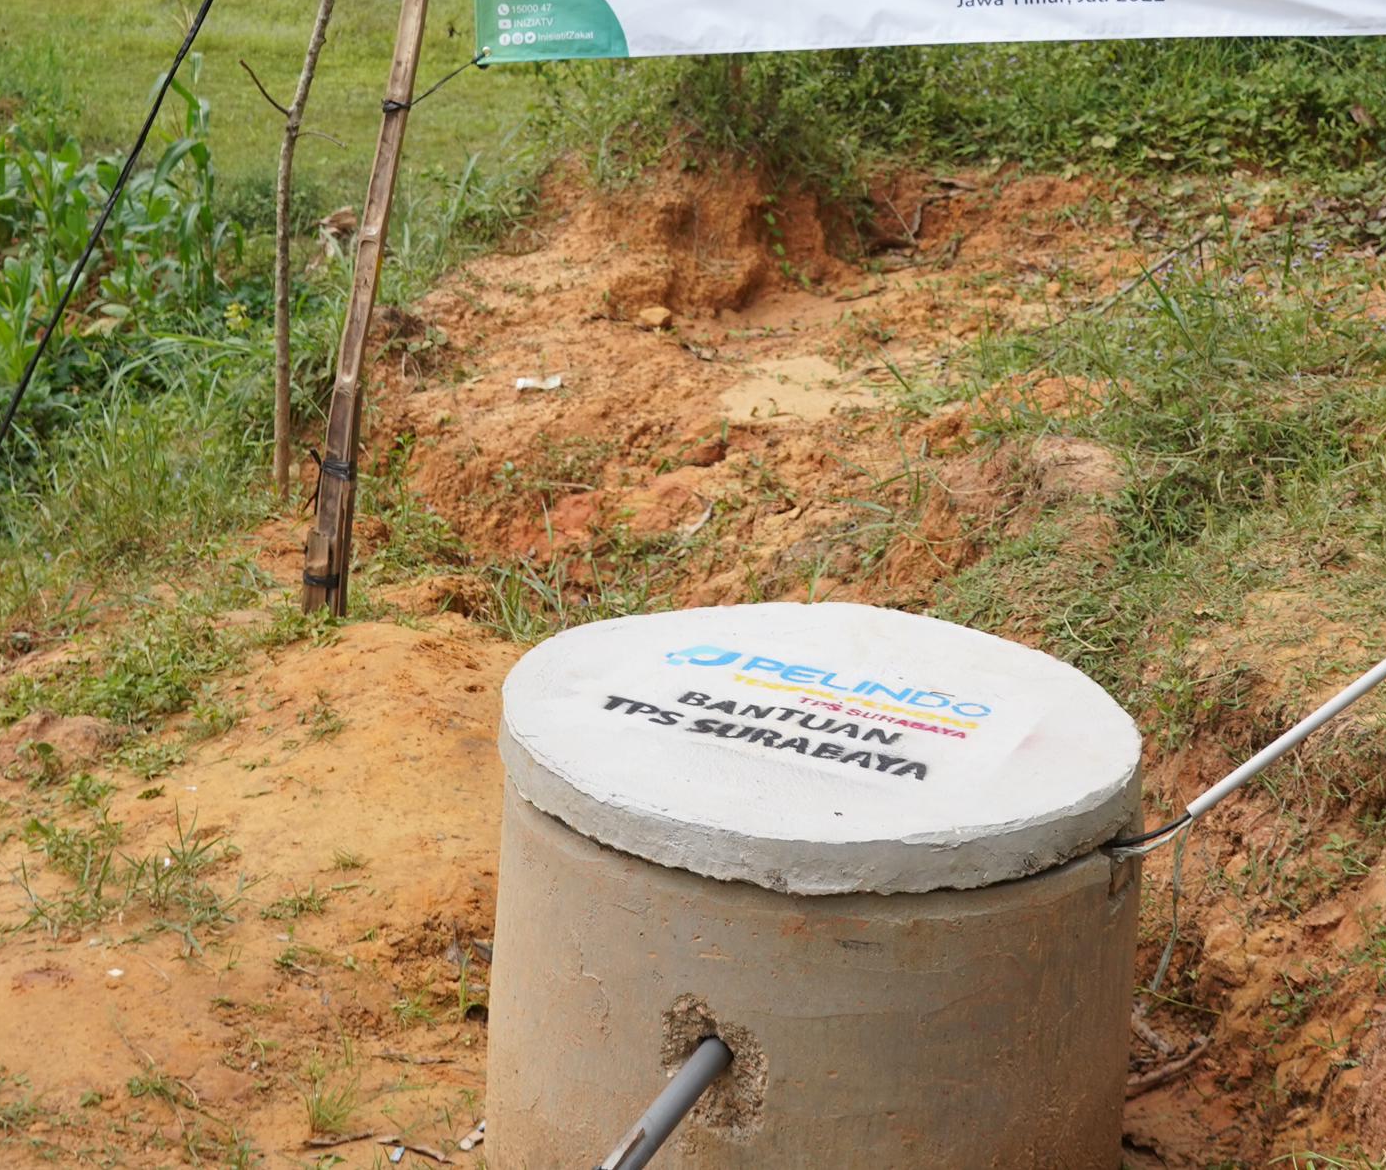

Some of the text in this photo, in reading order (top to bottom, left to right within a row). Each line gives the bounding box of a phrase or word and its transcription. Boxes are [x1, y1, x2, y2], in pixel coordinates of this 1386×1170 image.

[741, 655, 992, 718] PELINDO
[601, 694, 681, 727] TPS
[683, 717, 927, 781] SURABAYA
[676, 690, 903, 746] BANTUAN
[798, 696, 843, 712] TPS
[845, 707, 967, 740] SURABAYA
